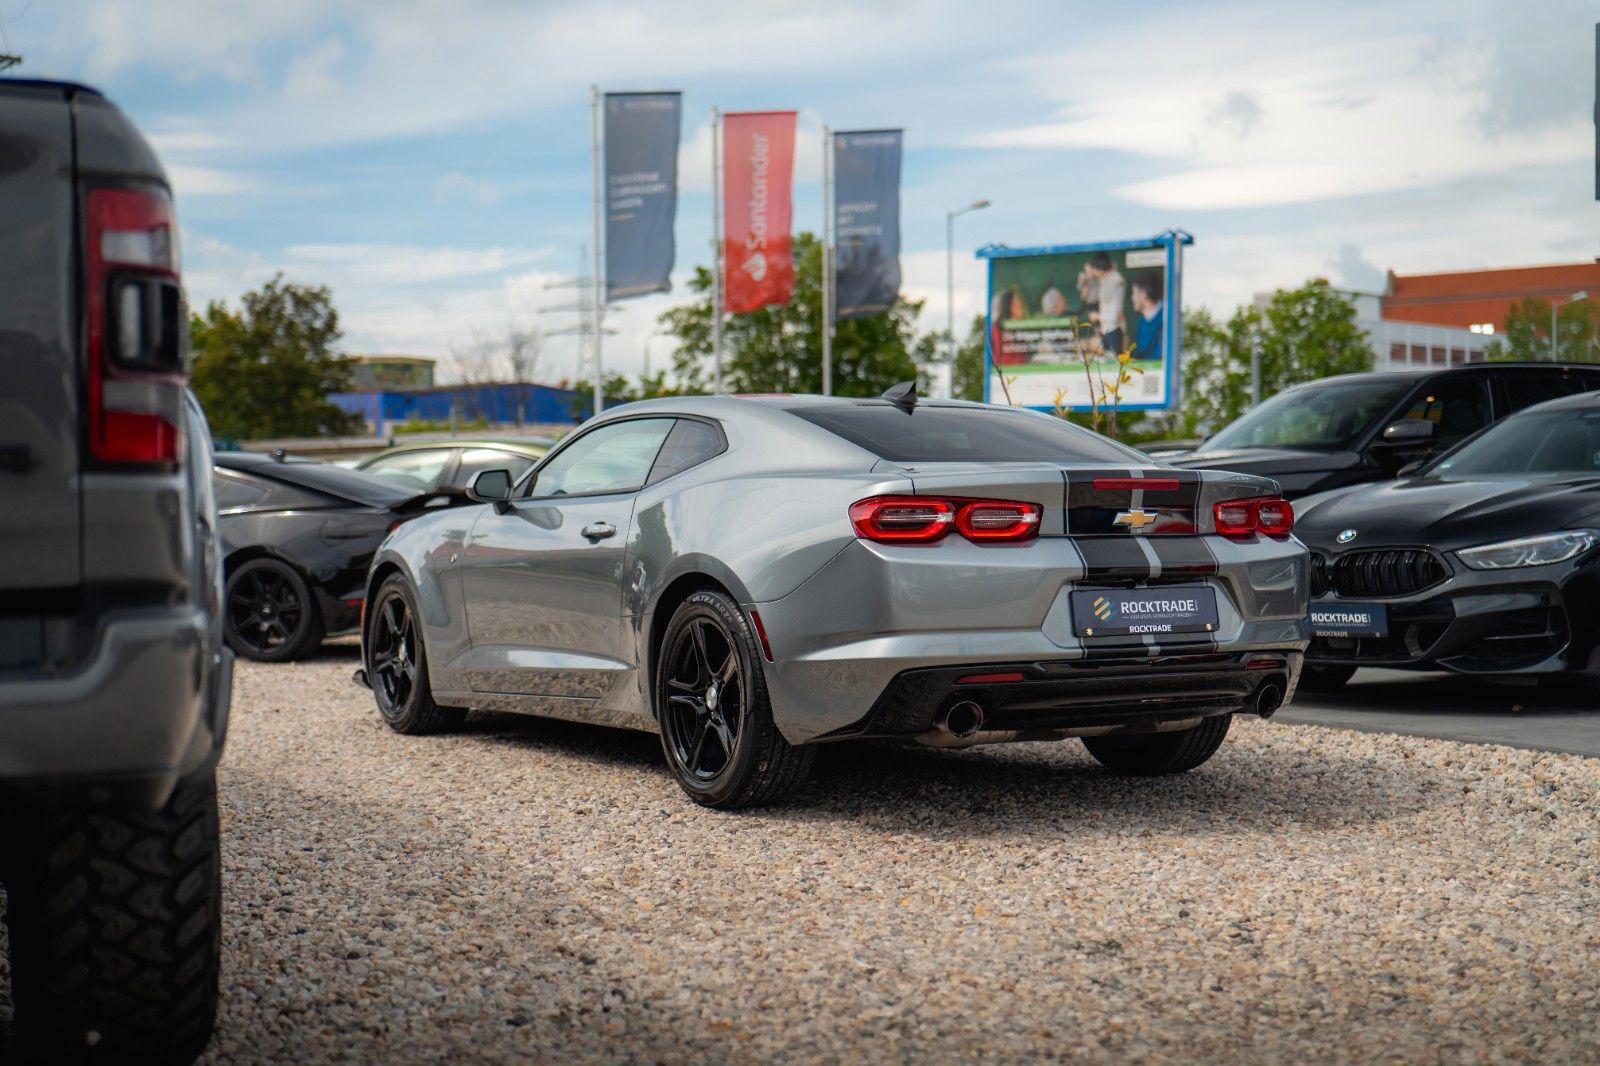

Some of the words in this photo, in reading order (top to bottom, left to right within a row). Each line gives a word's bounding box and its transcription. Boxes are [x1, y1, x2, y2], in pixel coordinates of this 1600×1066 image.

[747, 133, 769, 249] Santander
[692, 594, 714, 605] ULTRA
[1121, 600, 1195, 614] ROCKTRADE
[1311, 613, 1368, 623] ROCKTRADE
[1129, 624, 1172, 633] ROCKTRADE
